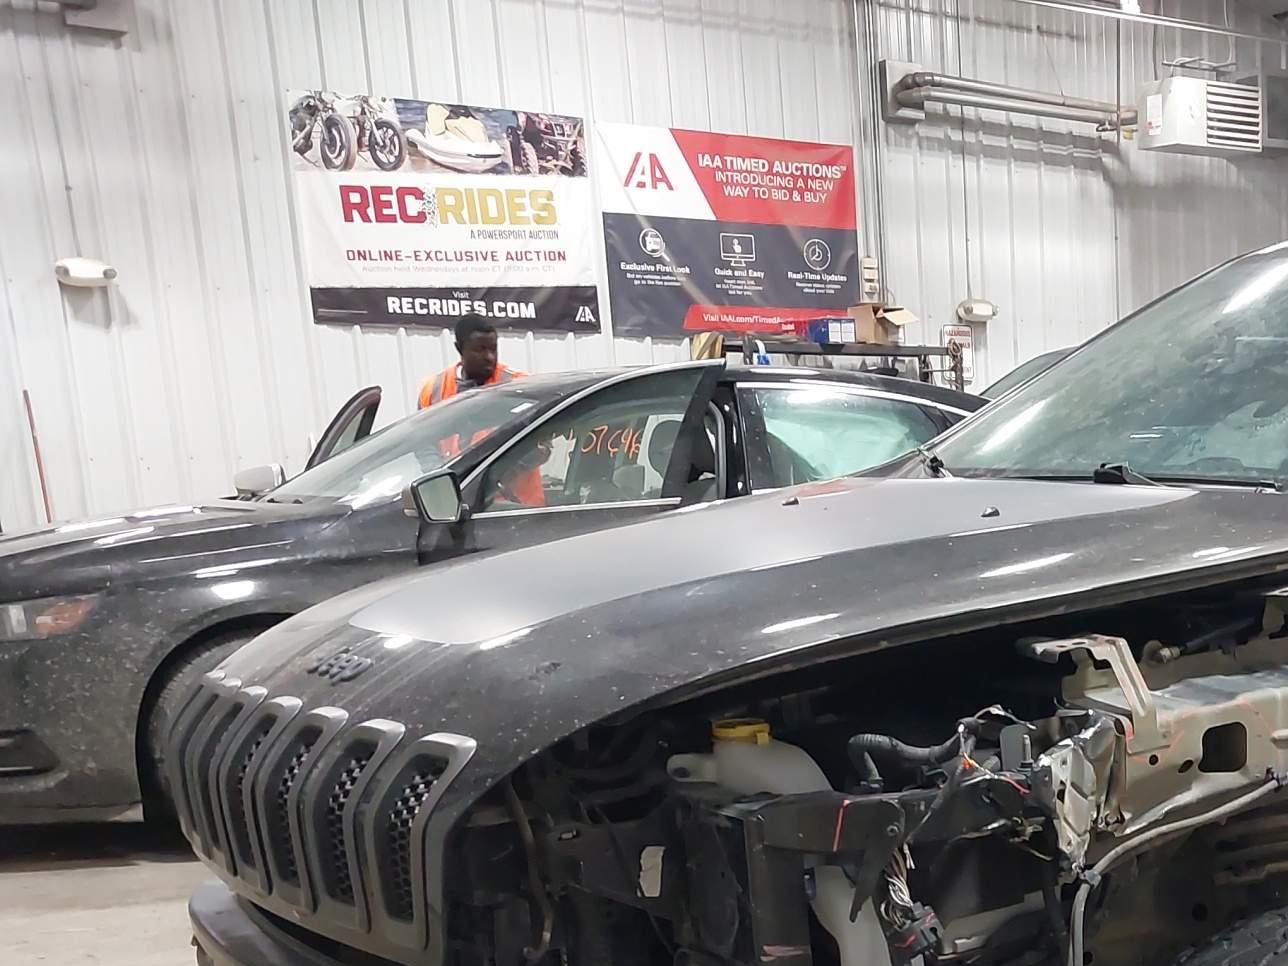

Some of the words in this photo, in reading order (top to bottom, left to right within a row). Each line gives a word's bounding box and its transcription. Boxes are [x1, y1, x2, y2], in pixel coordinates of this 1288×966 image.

[698, 154, 722, 168] IAA
[724, 157, 769, 173] TIMED
[715, 171, 793, 188] INTRODUCING
[797, 178, 805, 188] A
[808, 180, 833, 191] NEW
[724, 186, 749, 199] WAY
[753, 188, 768, 198] TO
[772, 189, 789, 201] BID
[793, 191, 801, 201] &
[804, 192, 827, 203] BUY
[339, 185, 427, 223] REC
[435, 187, 557, 225] RIDES
[470, 229, 476, 240] A
[477, 230, 527, 240] POWERSPORT
[528, 229, 559, 240] AUCTION
[346, 249, 499, 262] ONLINE-EXCLUSIVE
[505, 250, 567, 262] AUCTION
[621, 262, 655, 271] Exclusive
[656, 263, 672, 273] First
[715, 268, 733, 277] Quick
[748, 270, 764, 279] Easy
[788, 271, 820, 280] Real-Time
[822, 273, 847, 282] Updates
[452, 291, 469, 299] Visit
[386, 296, 536, 319] RECRIDES.COM
[703, 313, 719, 321] Visit
